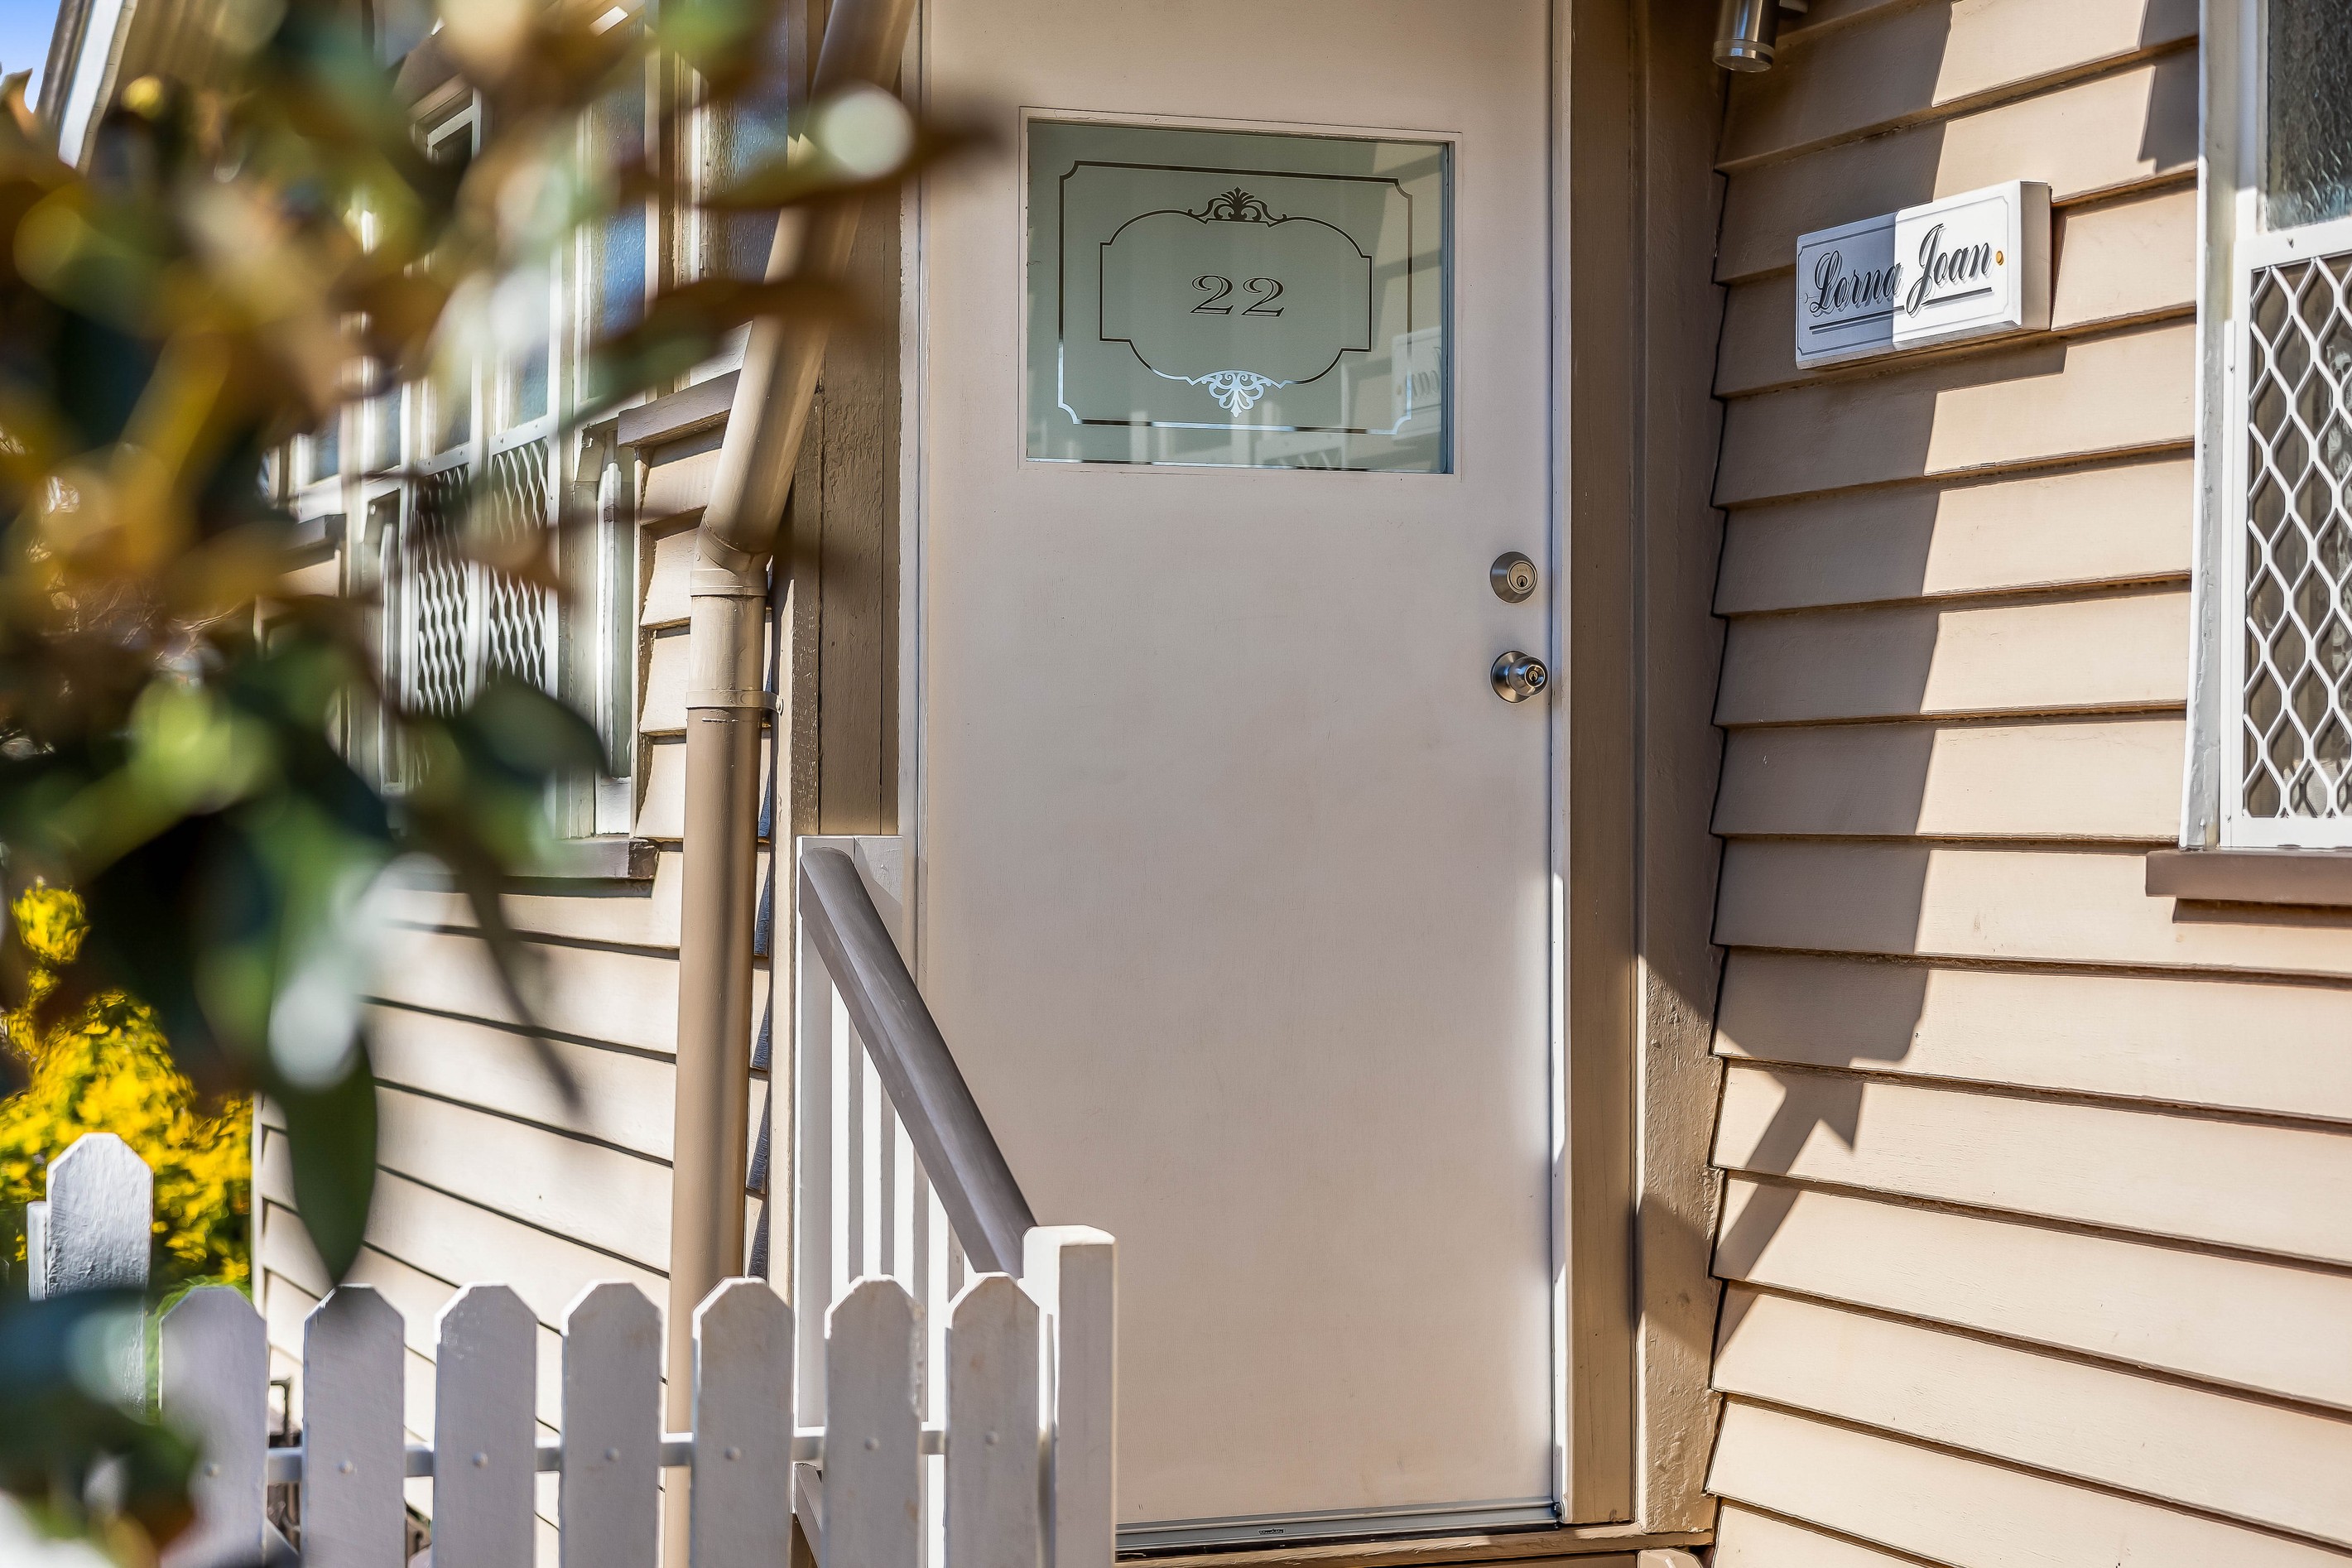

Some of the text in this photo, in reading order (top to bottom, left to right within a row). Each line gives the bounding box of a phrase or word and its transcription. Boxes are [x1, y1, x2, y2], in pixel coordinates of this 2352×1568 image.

[1190, 274, 1285, 318] 22
[1809, 223, 1992, 317] Lorna Joan
